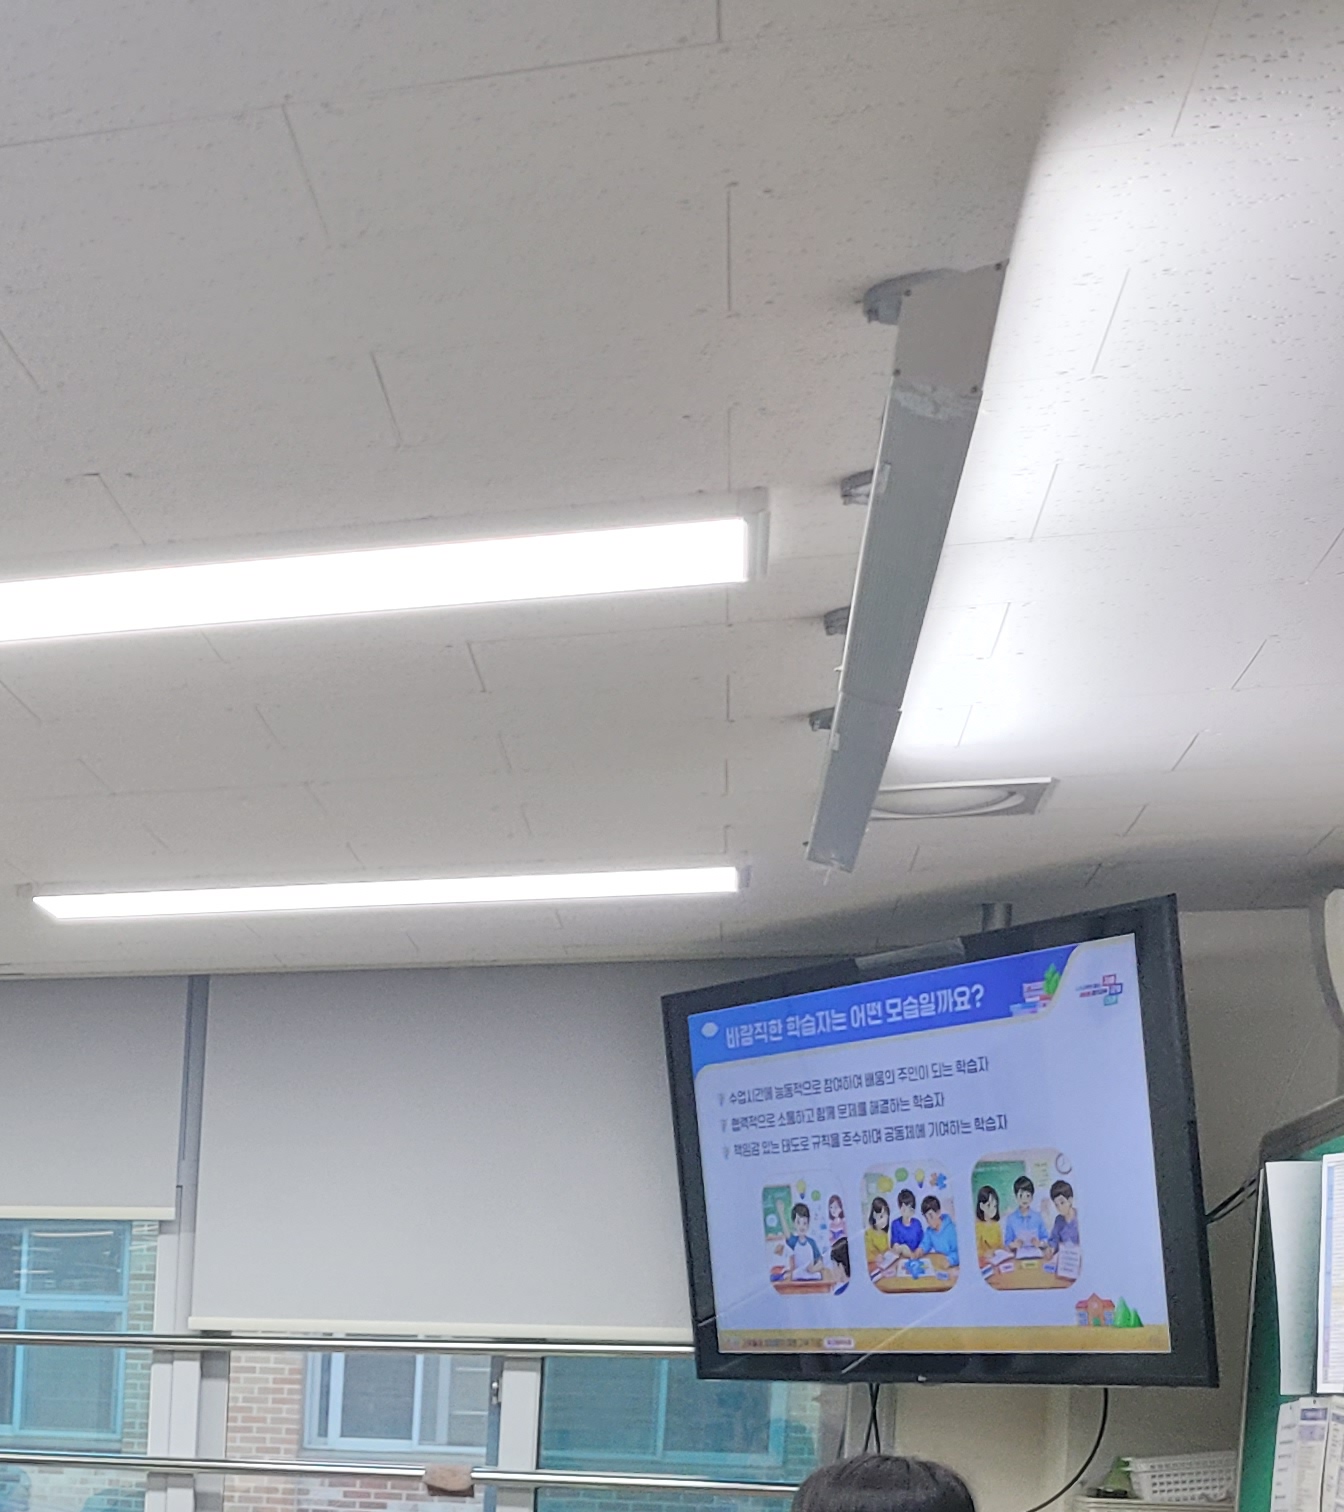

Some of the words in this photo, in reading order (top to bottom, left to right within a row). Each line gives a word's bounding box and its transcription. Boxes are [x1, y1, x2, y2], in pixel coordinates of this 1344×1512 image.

[725, 1019, 783, 1049] 바람직한
[786, 1009, 847, 1038] 학습자는
[850, 1001, 884, 1029] 어떤
[885, 983, 985, 1023] 모습일까요?
[897, 1064, 929, 1082] 주인이
[931, 1062, 953, 1079] 되는
[956, 1056, 989, 1075] 학습자
[913, 1092, 945, 1109] 학습자
[928, 1119, 972, 1138] 기여하는
[974, 1114, 1008, 1132] 학습자
